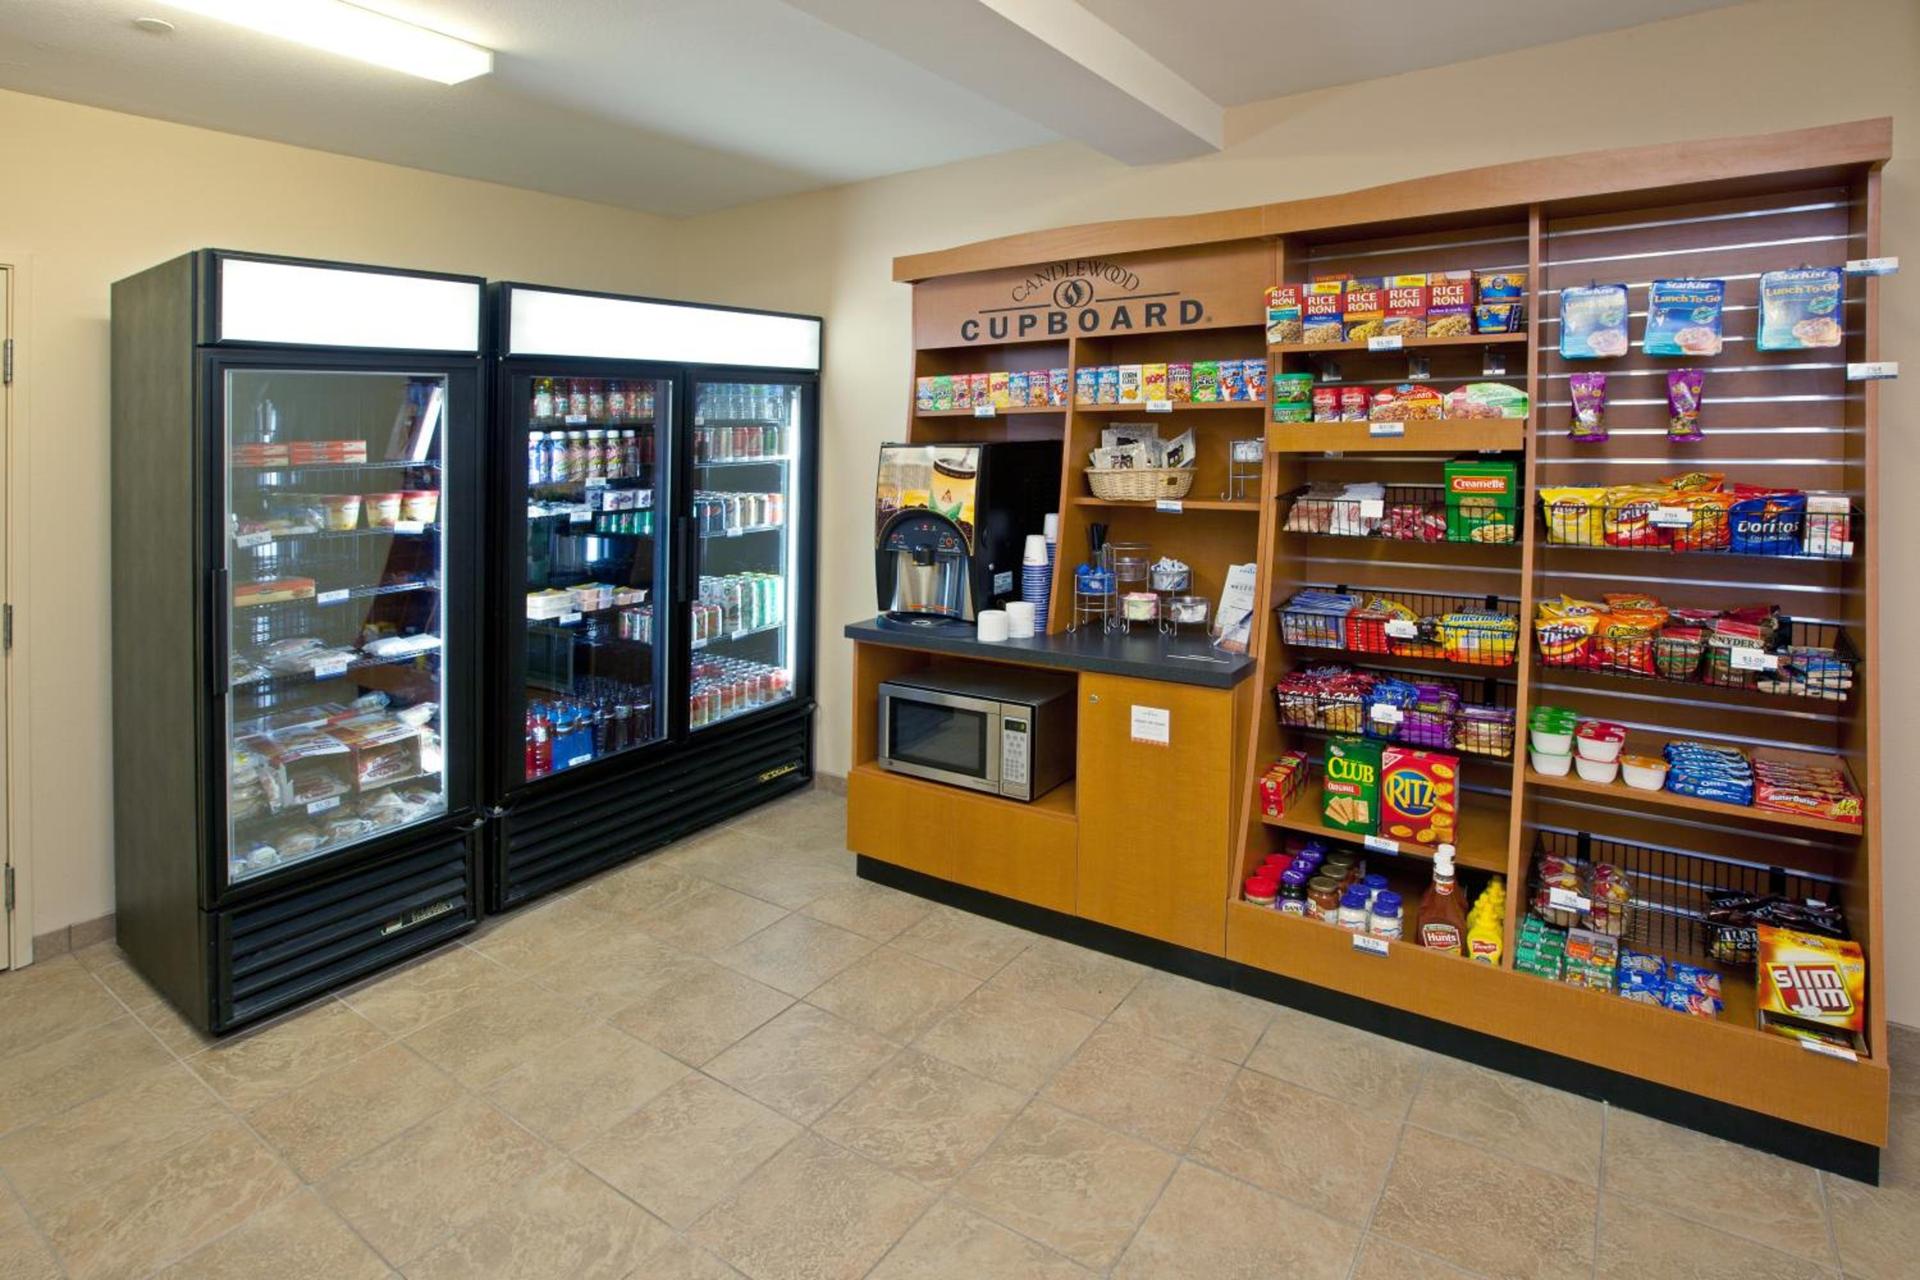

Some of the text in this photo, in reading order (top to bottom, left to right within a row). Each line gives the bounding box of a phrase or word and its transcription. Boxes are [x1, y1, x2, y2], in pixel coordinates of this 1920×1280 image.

[1012, 260, 1140, 302] CANDLEWOOD
[1665, 282, 1712, 290] StarKist
[1271, 288, 1295, 297] RICE
[1389, 288, 1420, 299] RICE
[1432, 285, 1464, 296] RICE
[1766, 287, 1803, 296] Lunch
[1271, 297, 1296, 306] RONI
[1308, 295, 1336, 305] RICE
[1347, 292, 1377, 302] RICE
[1432, 295, 1464, 306] RONI
[1654, 295, 1721, 303] Lunch To-Go
[1347, 302, 1377, 311] RONI
[1389, 298, 1420, 308] RONI
[1308, 305, 1336, 314] RONI
[960, 299, 1204, 342] CUPBOARD
[1453, 478, 1505, 491] Creamette
[1737, 519, 1800, 533] Doritos
[1540, 624, 1587, 645] Fritos
[1327, 756, 1375, 783] CLUB
[1388, 775, 1435, 809] RITZ
